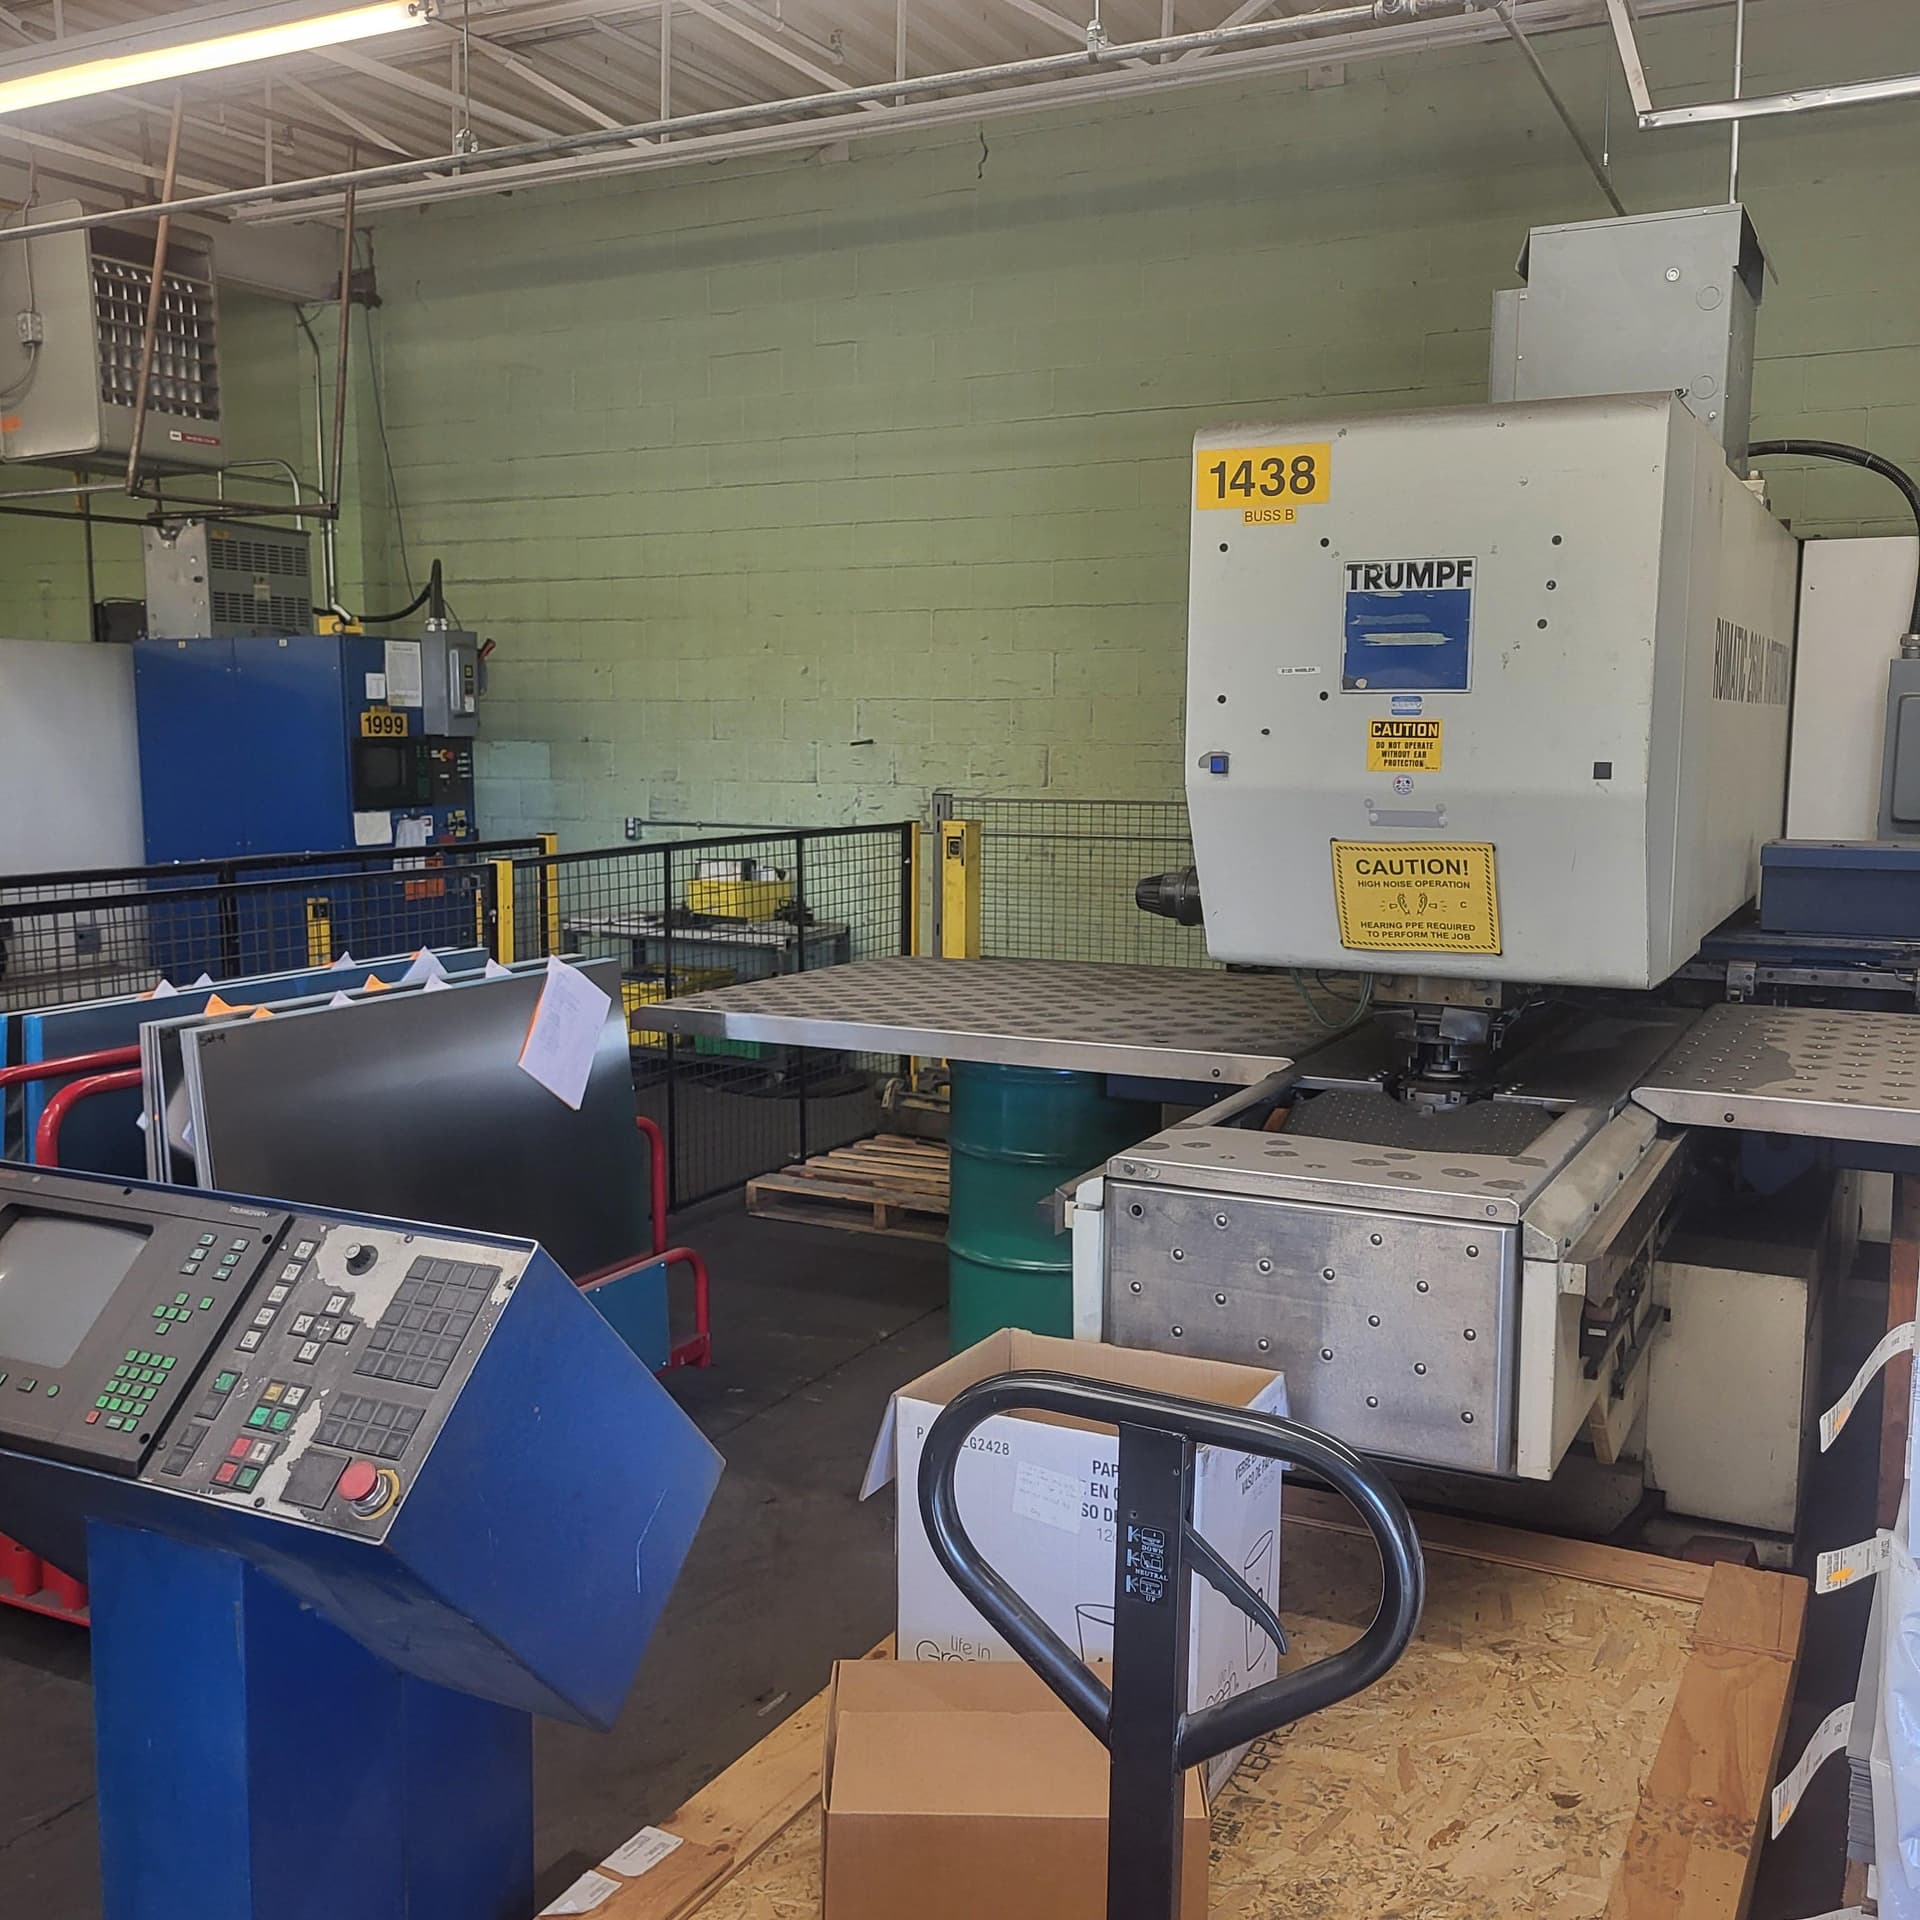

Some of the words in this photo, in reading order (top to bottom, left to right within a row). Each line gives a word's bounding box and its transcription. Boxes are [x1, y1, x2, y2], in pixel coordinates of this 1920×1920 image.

[1210, 455, 1316, 499] 1438
[1244, 509, 1281, 523] BUSS
[1285, 508, 1294, 520] B
[1346, 559, 1473, 590] TRUMPF
[364, 715, 404, 735] 1999
[1372, 722, 1439, 737] CAUTION
[1404, 742, 1434, 750] OPERATE
[1381, 750, 1410, 758] WITHOUT
[1414, 751, 1427, 759] EAR
[1383, 759, 1424, 768] PROTECTION
[1356, 859, 1469, 876] CAUTION!
[1358, 879, 1381, 888] HIGH
[1383, 880, 1412, 888] NOISE
[1415, 880, 1470, 889] OPERATION
[1360, 921, 1403, 929] HEARING
[1405, 922, 1424, 930] PPE
[1426, 922, 1476, 932] REQUIRED
[1367, 930, 1380, 938] TO
[1382, 931, 1428, 939] PERFORM
[1431, 932, 1449, 940] THE
[1451, 933, 1471, 941] JOB
[1092, 1460, 1119, 1478] PAP
[1090, 1482, 1109, 1499] EN
[1141, 1544, 1163, 1554] DOWN
[1135, 1568, 1168, 1582] NEUTRAL
[951, 1635, 972, 1655] life
[978, 1643, 990, 1660] in
